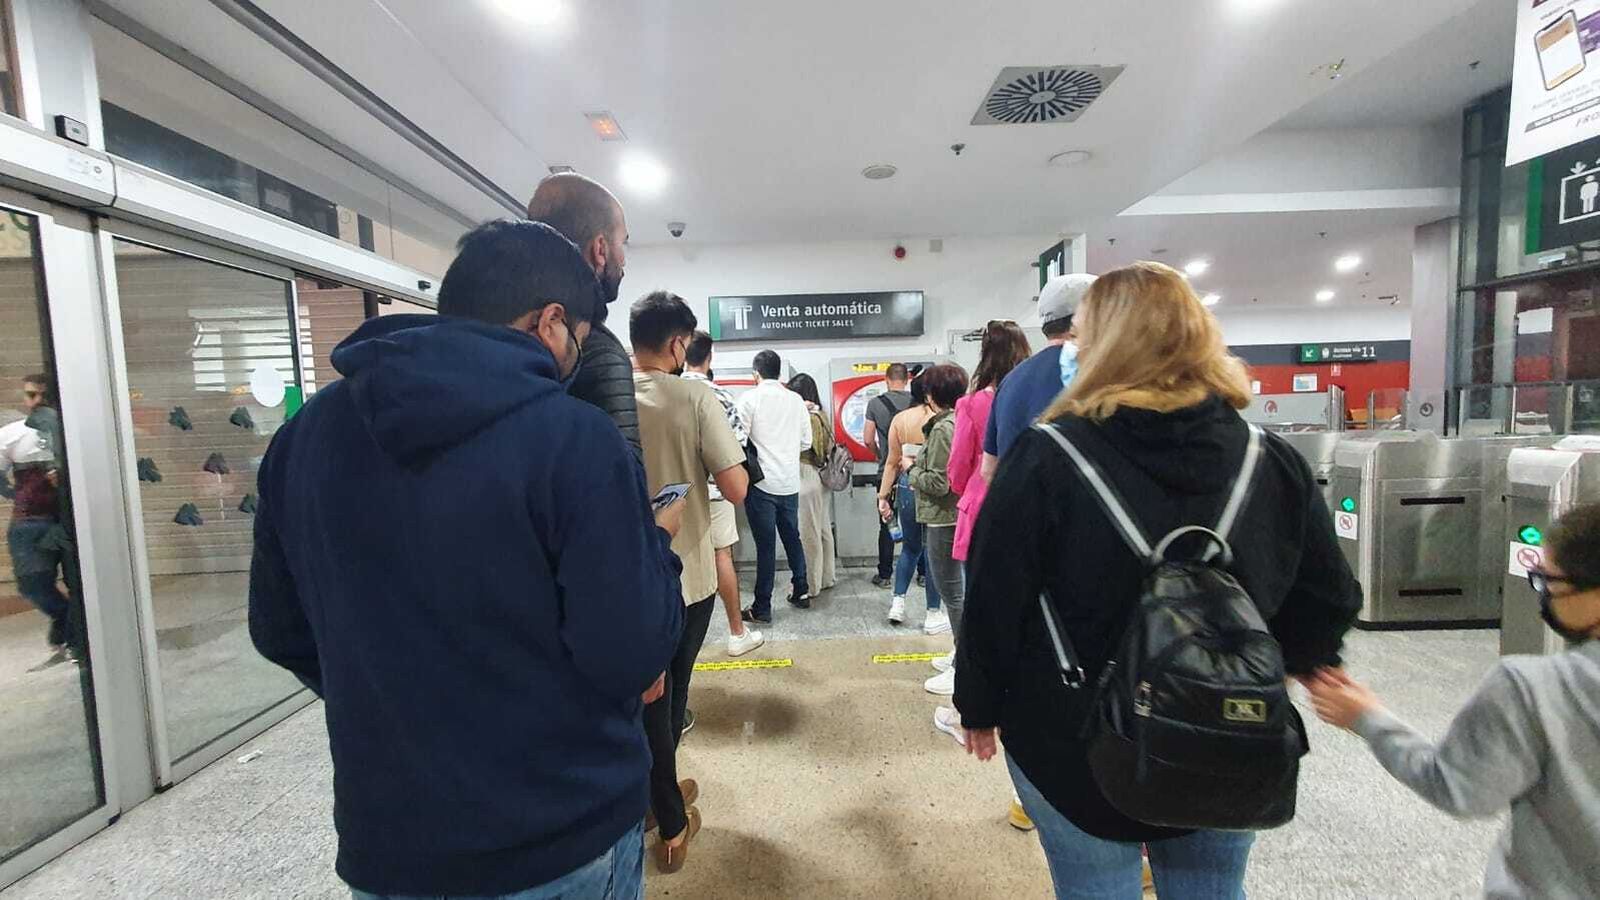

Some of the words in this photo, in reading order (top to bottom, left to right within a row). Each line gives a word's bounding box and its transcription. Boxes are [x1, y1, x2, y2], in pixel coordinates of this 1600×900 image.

[760, 304, 800, 318] Venta
[804, 301, 882, 317] automática
[761, 321, 803, 329] AUTOMATIC
[805, 320, 830, 328] TICKET
[832, 319, 854, 328] SALES
[1361, 346, 1376, 358] 11
